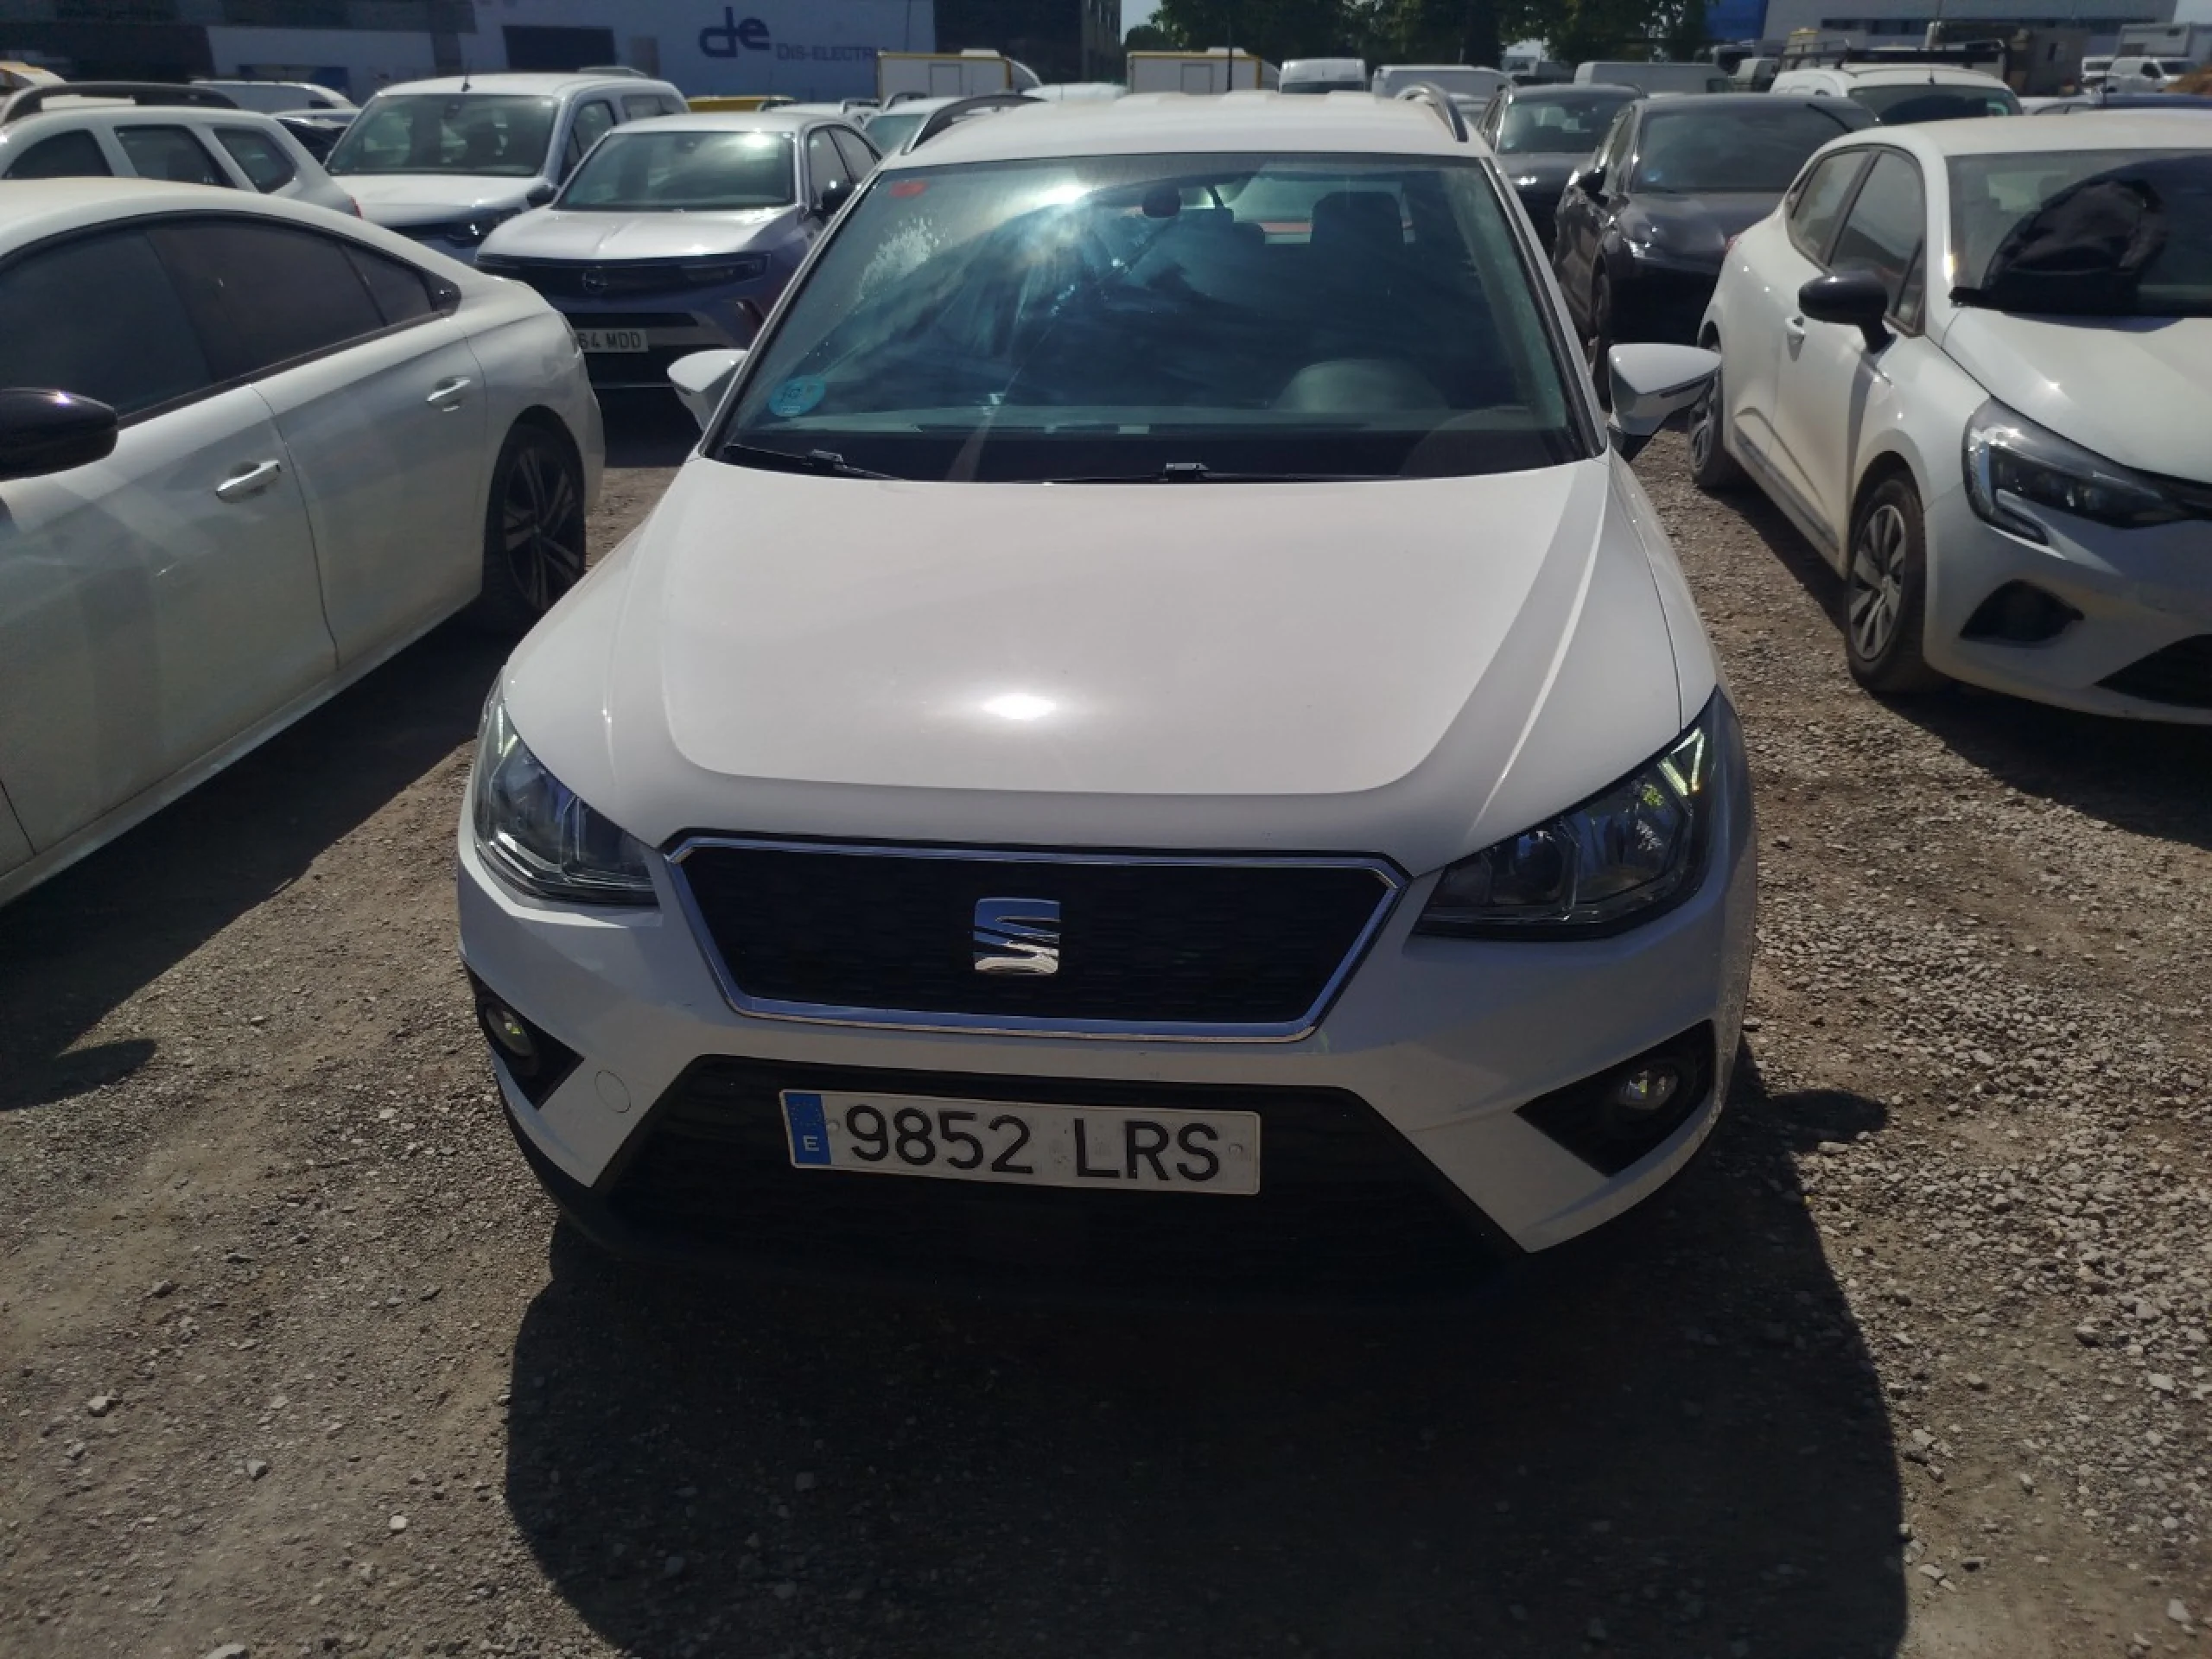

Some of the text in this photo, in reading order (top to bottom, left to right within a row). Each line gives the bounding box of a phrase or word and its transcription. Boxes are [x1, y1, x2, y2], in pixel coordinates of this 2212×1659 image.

[699, 7, 772, 58] de
[803, 1135, 820, 1152] E
[844, 1104, 1220, 1181] 9852 LRS
